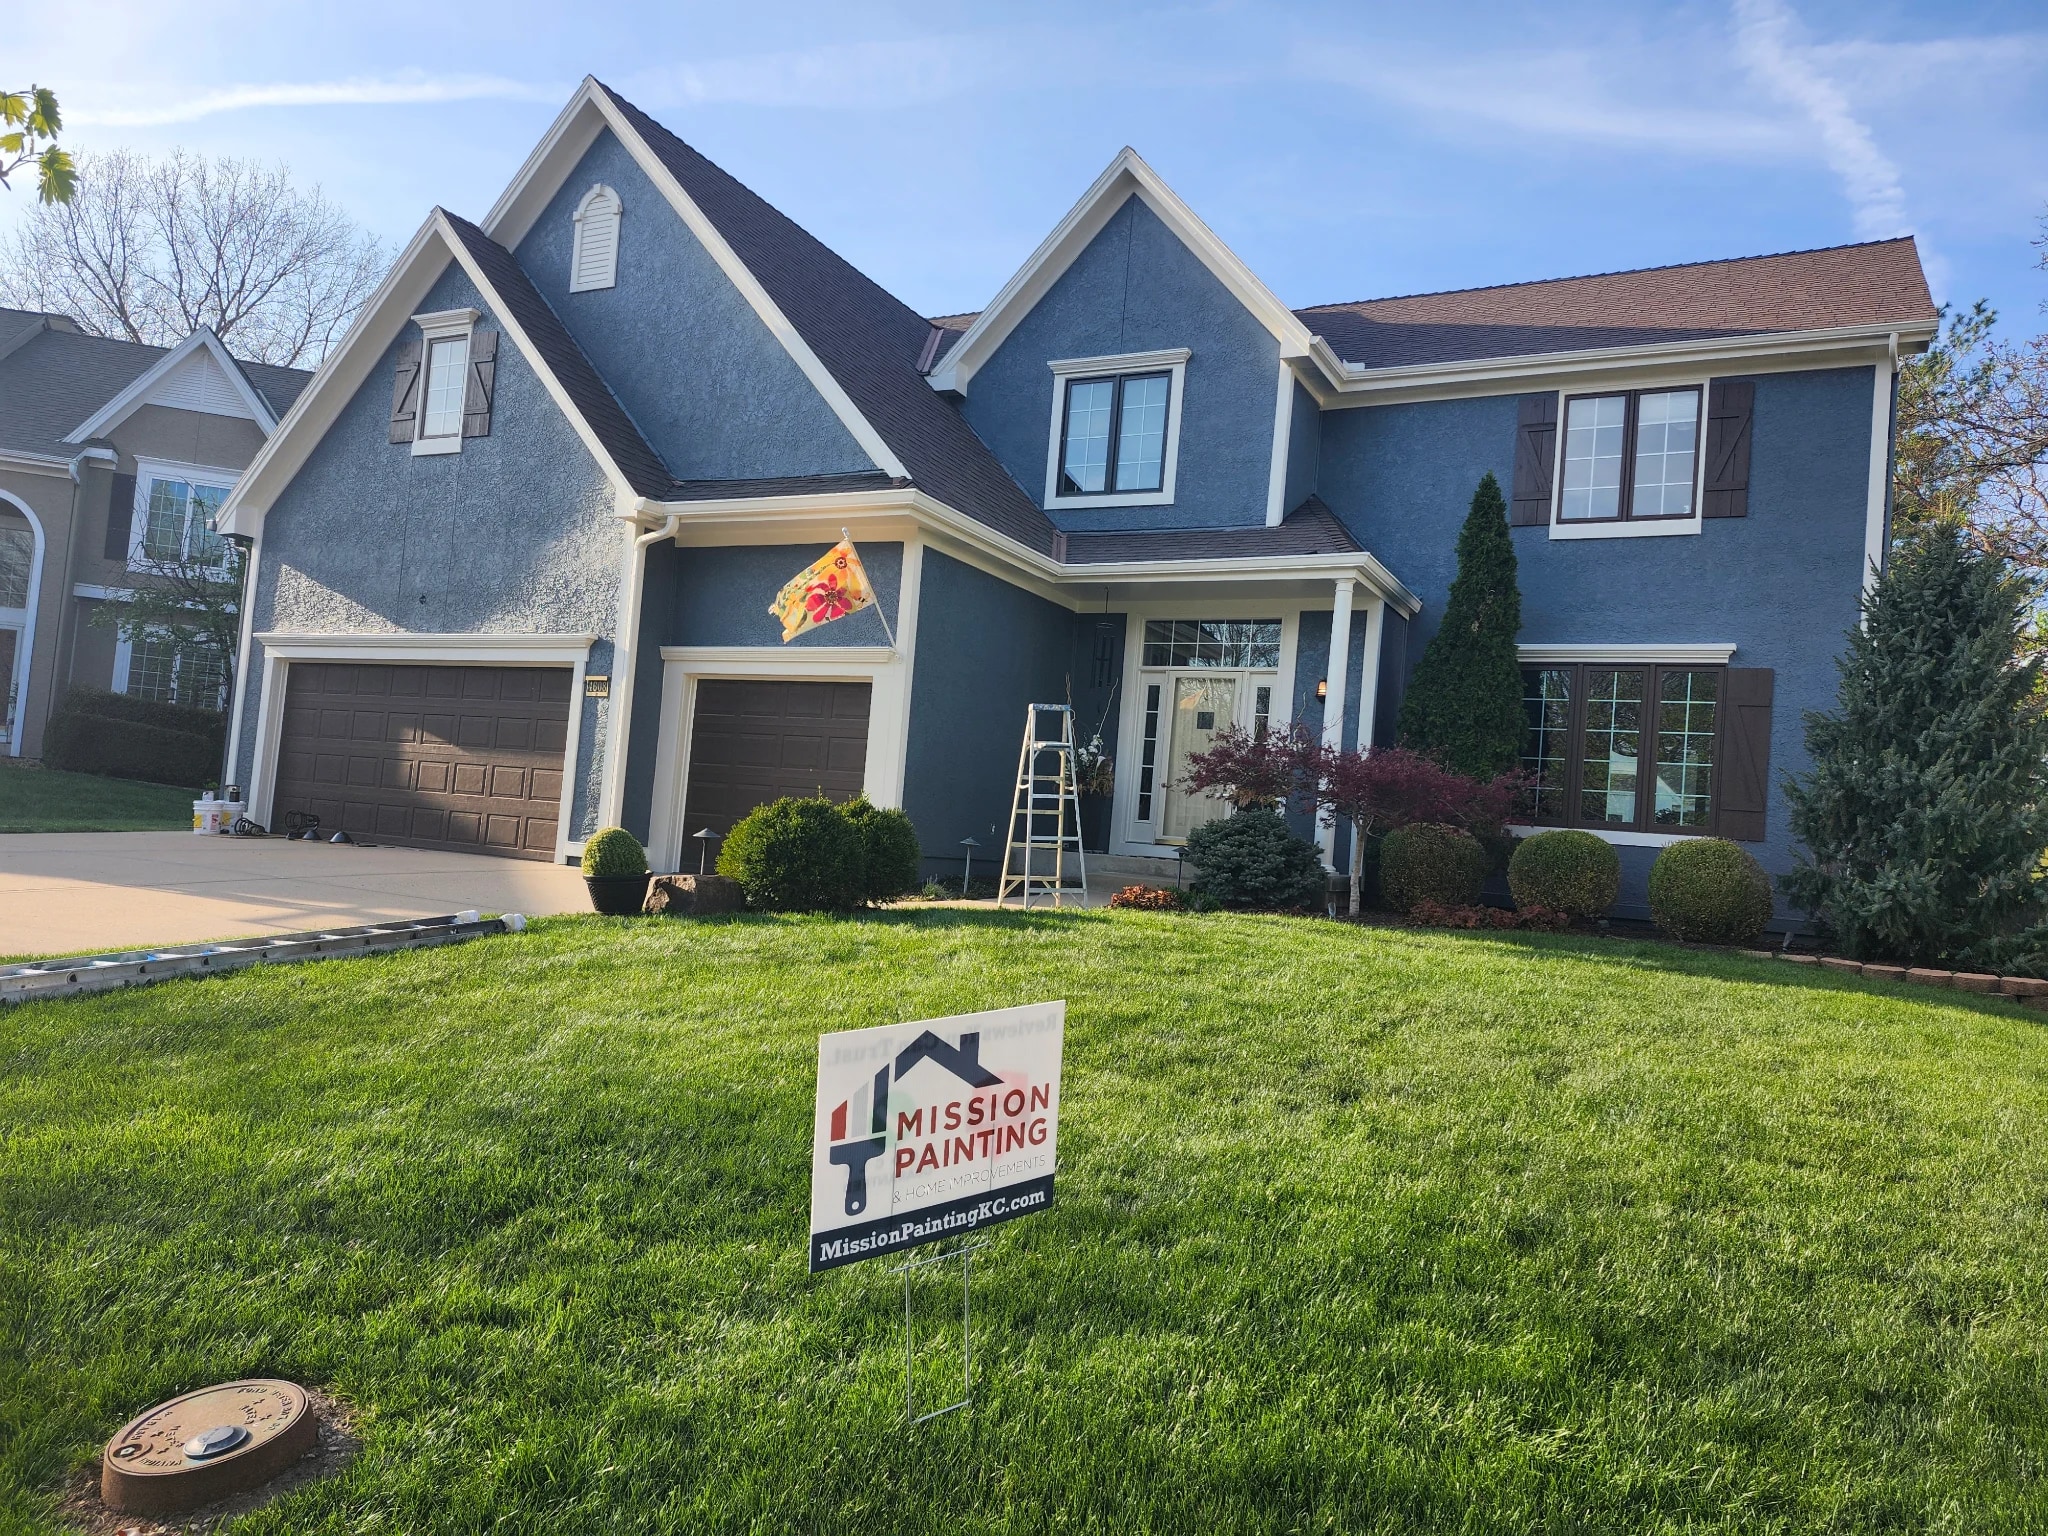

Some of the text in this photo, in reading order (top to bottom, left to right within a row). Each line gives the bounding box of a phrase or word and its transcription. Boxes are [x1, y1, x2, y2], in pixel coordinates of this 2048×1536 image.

[896, 1083, 1050, 1141] MISSION
[895, 1118, 1047, 1178] PAINTING
[892, 1190, 902, 1203] &
[906, 1180, 946, 1200] HOME
[949, 1155, 1046, 1190] IMPROVEMENTS
[819, 1189, 1045, 1262] MissionPaintingKC.com
